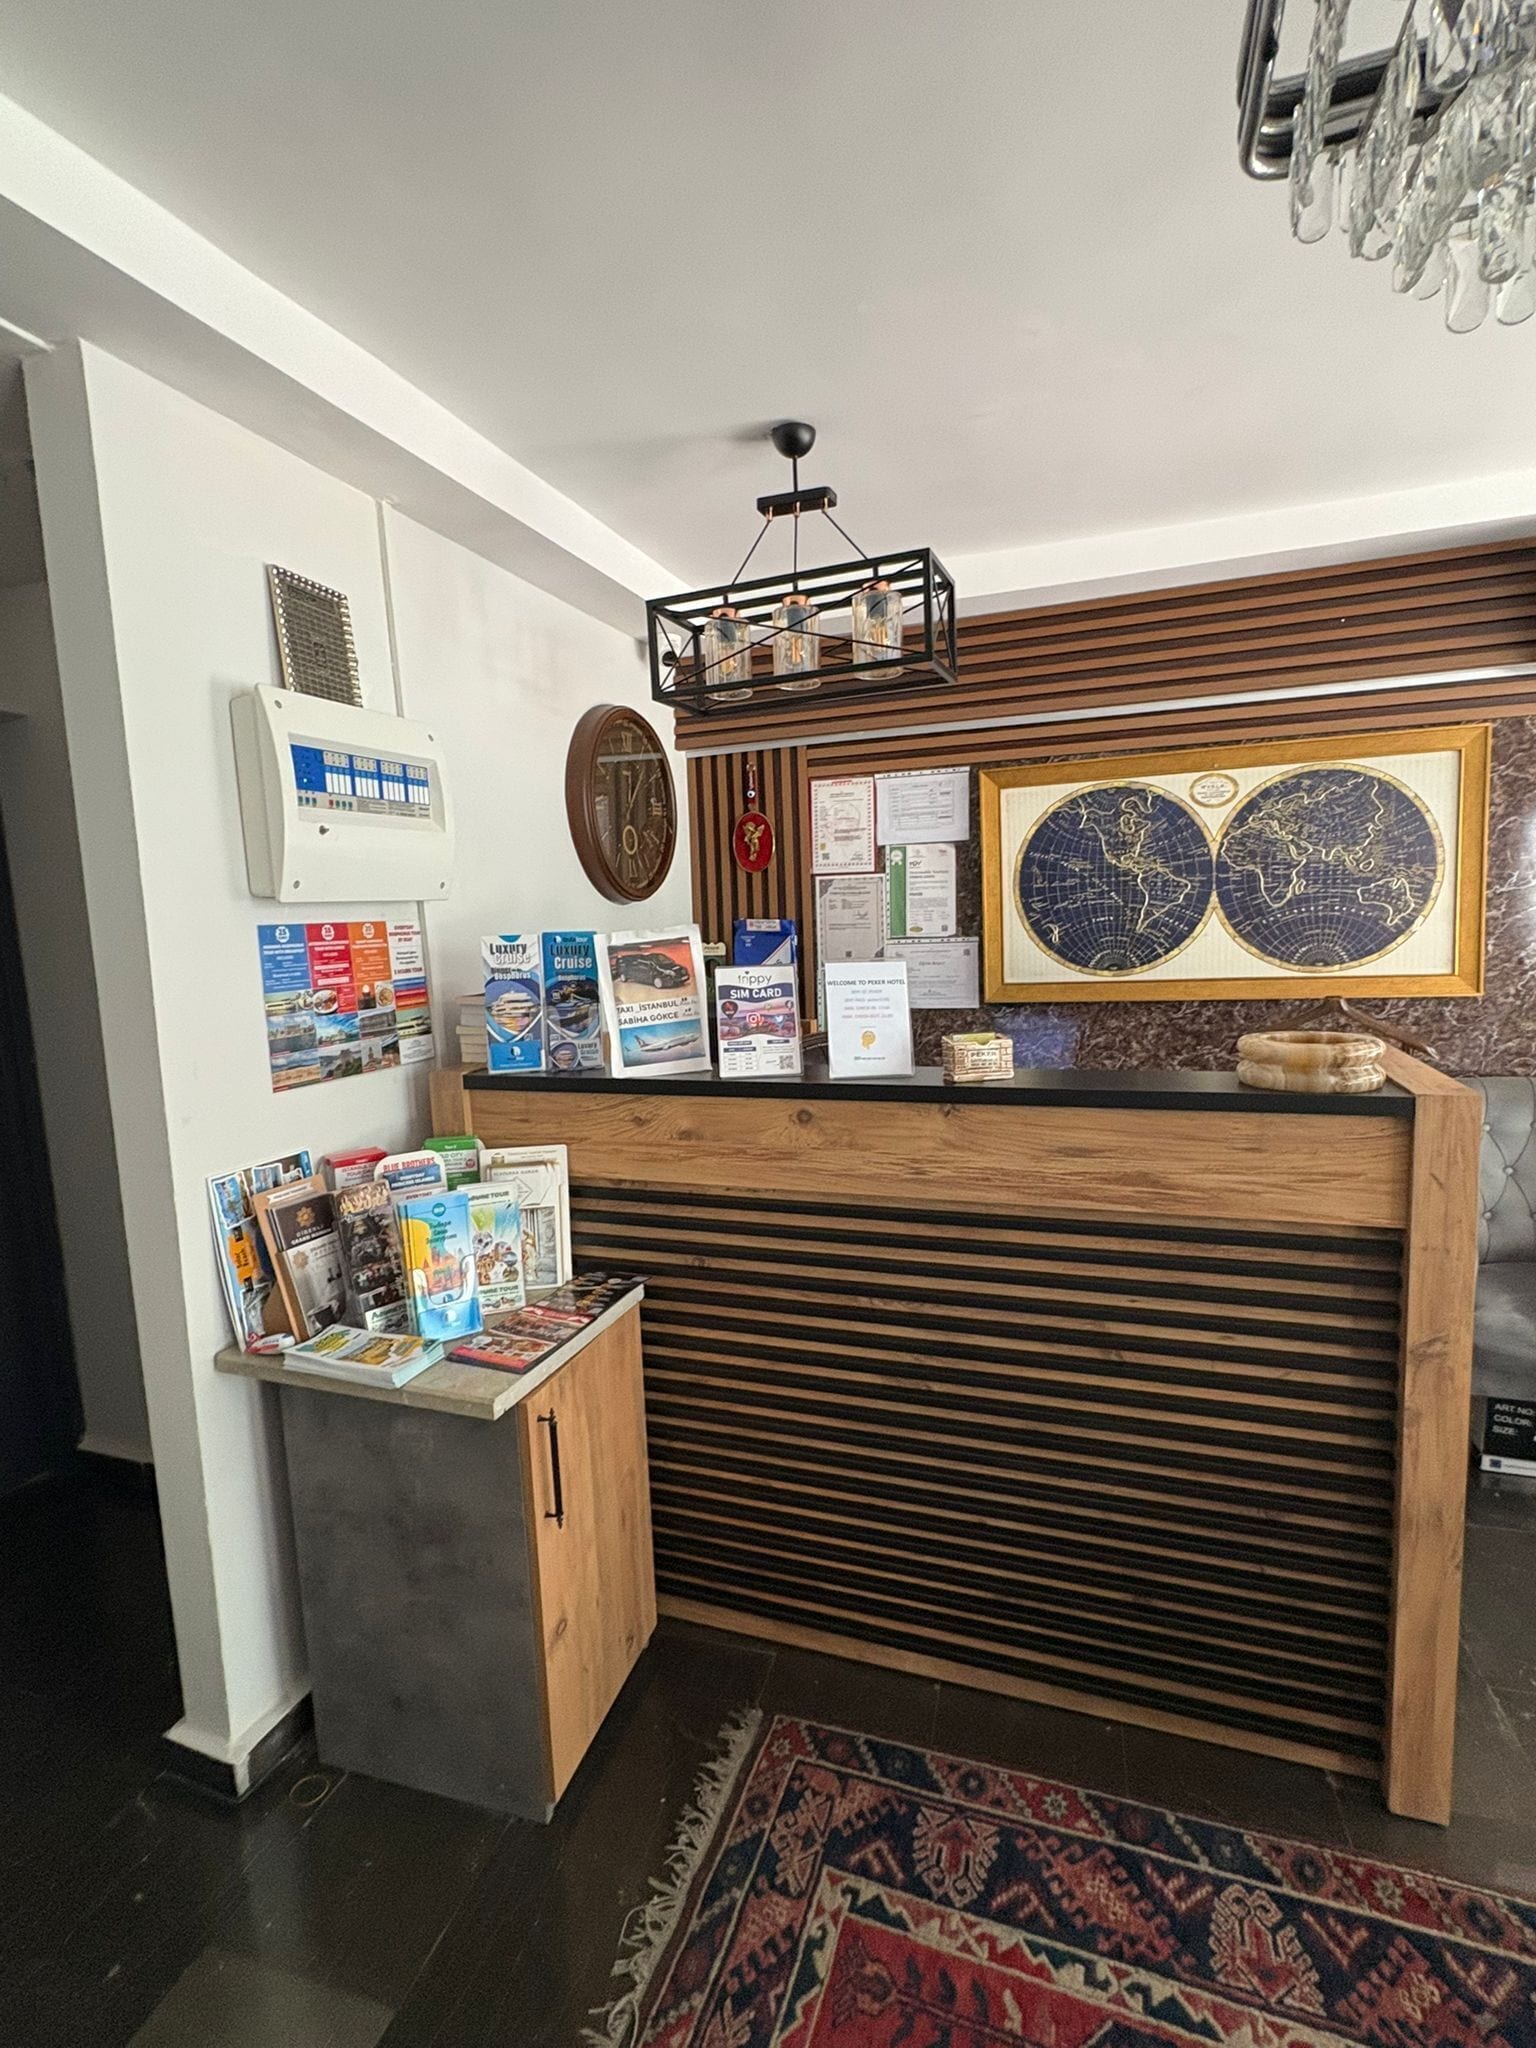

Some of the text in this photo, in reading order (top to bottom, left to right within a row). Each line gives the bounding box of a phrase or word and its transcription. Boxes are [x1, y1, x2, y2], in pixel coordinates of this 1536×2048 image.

[489, 943, 528, 956] Luxury
[550, 944, 590, 957] Luxury
[493, 952, 532, 965] Cruise
[553, 956, 592, 970] Cruise
[738, 971, 773, 986] trippy
[729, 988, 782, 1000] SIM CARD
[616, 1006, 634, 1014] TAXI
[1494, 1403, 1516, 1413] ART
